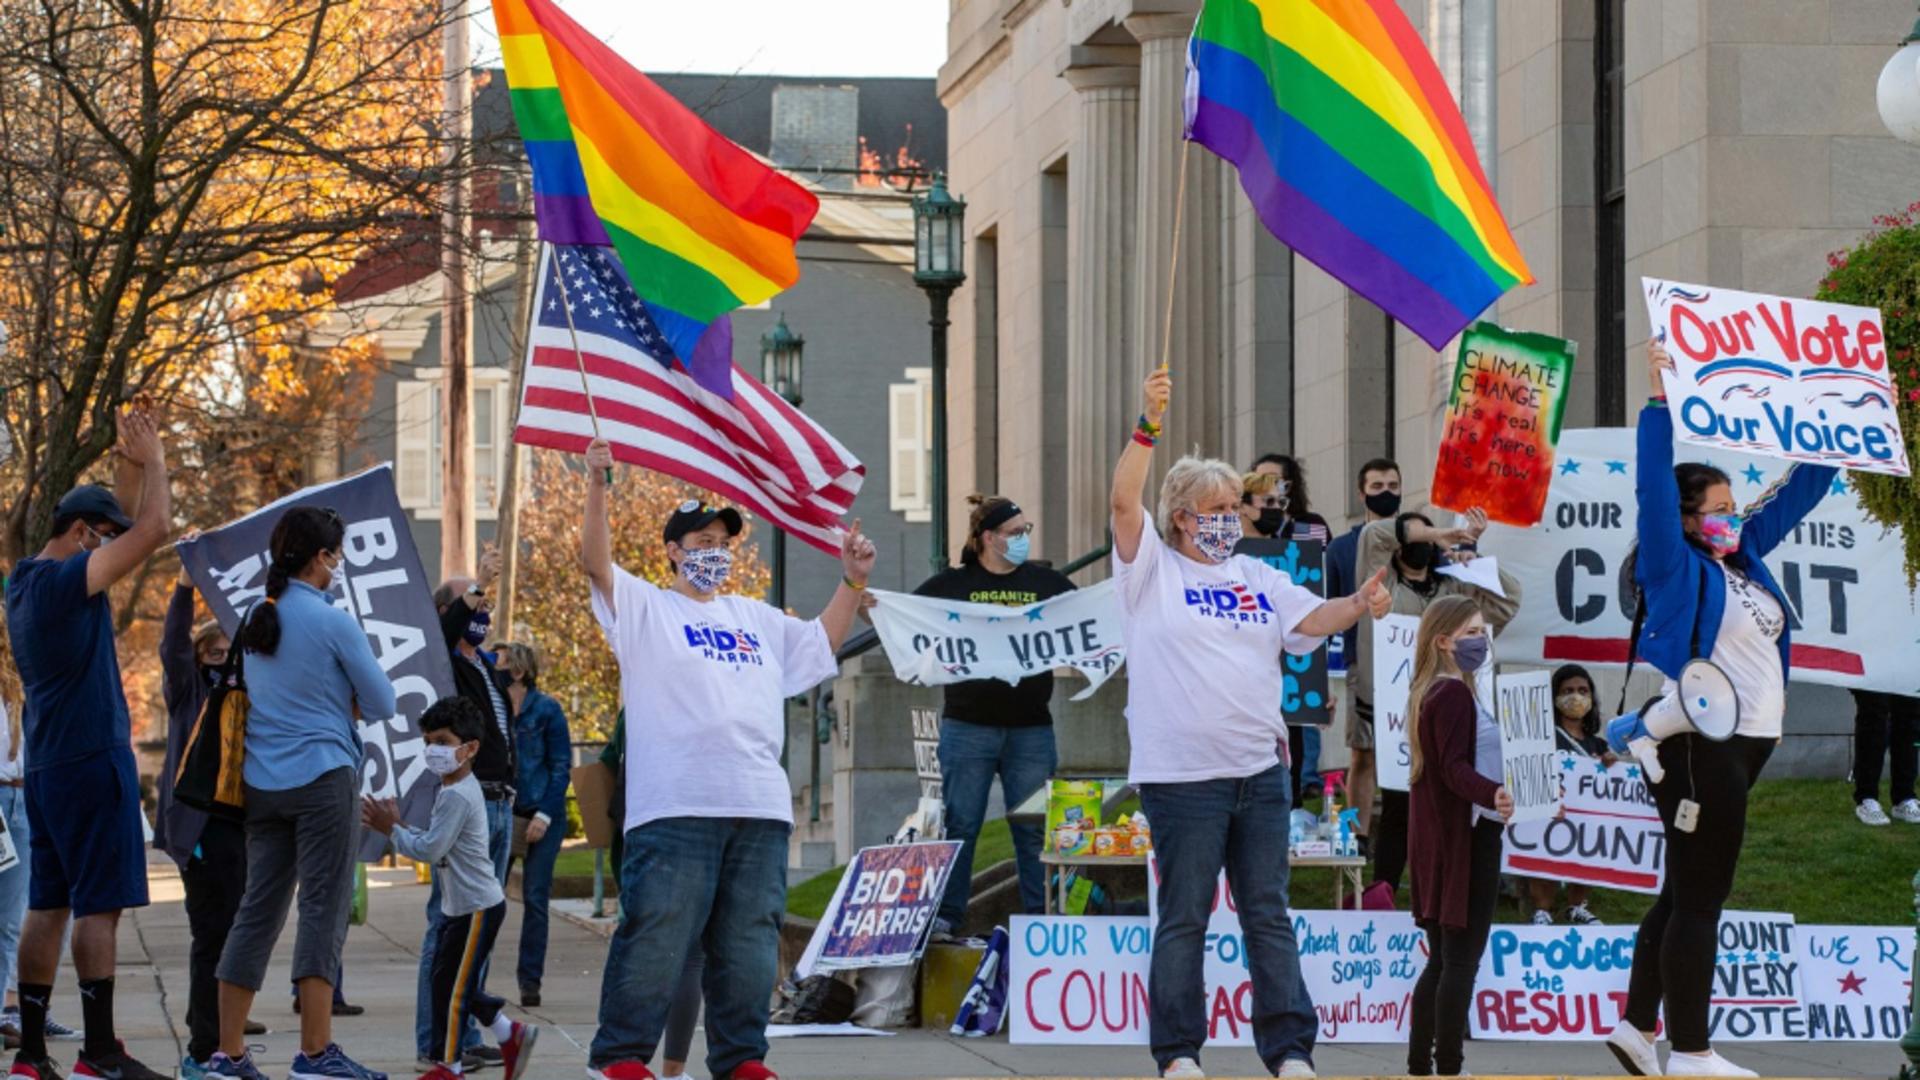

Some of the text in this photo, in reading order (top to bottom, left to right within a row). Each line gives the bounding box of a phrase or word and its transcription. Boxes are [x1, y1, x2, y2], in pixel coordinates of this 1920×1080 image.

[1670, 300, 1885, 372] Our Vote
[1463, 349, 1559, 389] CLIMATE
[1458, 372, 1543, 409] CHANGE
[1454, 396, 1537, 433] It's real
[1681, 395, 1893, 460] Our Voice
[1491, 432, 1536, 457] here
[1487, 459, 1530, 480] now
[1556, 502, 1622, 529] OUR
[970, 590, 1038, 602] ORGANIZE
[1185, 585, 1274, 613] BIDEN
[1199, 606, 1268, 624] HARRIS
[684, 624, 761, 653] BIDEN
[912, 619, 1103, 665] OUR VOTE
[343, 517, 438, 799] BLACK
[704, 648, 763, 666] HARRIS
[850, 866, 945, 905] BIDEN
[839, 905, 930, 937] HARRIS
[1025, 921, 1087, 957] OUR
[1294, 915, 1423, 956] Check out our
[1718, 921, 1794, 953] OUNT
[1810, 935, 1860, 965] WE
[1332, 953, 1416, 989] songs at
[1522, 970, 1564, 993] the
[1711, 961, 1798, 998] VERY
[1025, 968, 1151, 1033] COUN
[1476, 989, 1664, 1036] RESULT
